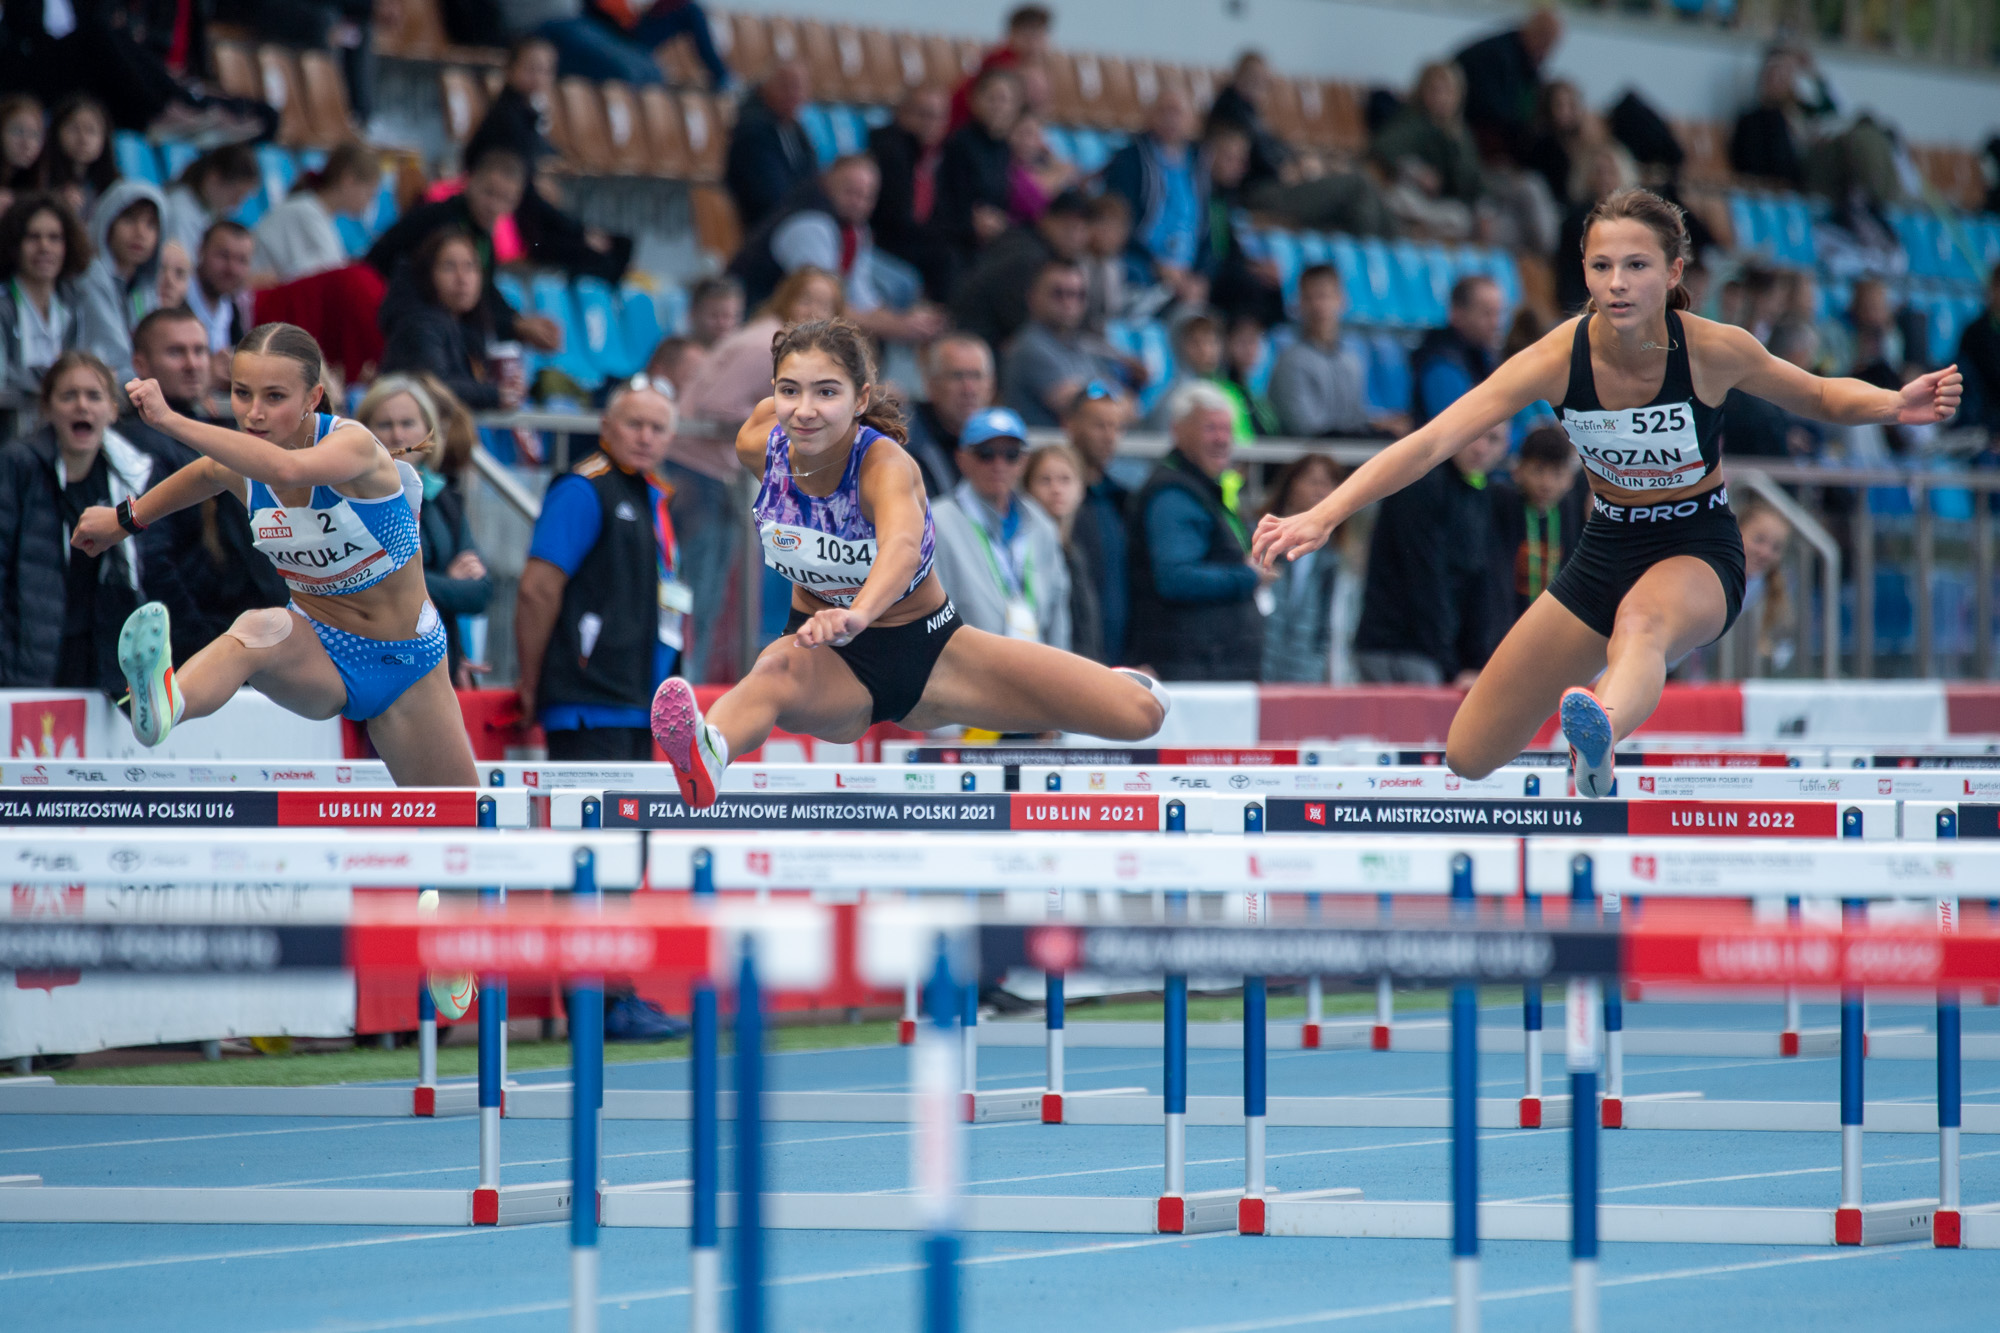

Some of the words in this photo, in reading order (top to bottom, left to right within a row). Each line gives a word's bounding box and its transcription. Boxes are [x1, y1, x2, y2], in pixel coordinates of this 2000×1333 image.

[1632, 407, 1686, 434] 525
[1582, 445, 1683, 466] KOZAN
[1602, 467, 1644, 488] LUBLIN
[1649, 474, 1685, 488] 2022
[1629, 500, 1699, 523] PRO
[260, 527, 292, 539] ORLEN
[316, 512, 338, 535] 2
[776, 536, 796, 546] LOTTO
[270, 541, 364, 568] KICUŁA
[815, 536, 873, 567] 1034
[296, 582, 338, 594] LUBLIN
[340, 568, 374, 588] 2022
[1180, 778, 1212, 789] FUEL
[1379, 777, 1424, 789] polanik
[36, 802, 144, 818] MISTRZOSTWA
[148, 803, 202, 818] POLSKI
[205, 802, 236, 818] U16
[318, 802, 383, 818] LUBLIN
[391, 802, 437, 818] 2022
[649, 803, 686, 818] PZLA
[689, 801, 788, 819] DRUŻYNOWE
[791, 804, 899, 820] MISTRZOSTWA
[903, 805, 956, 820] POLSKI
[960, 805, 996, 820] 2021
[1026, 805, 1091, 821] LUBLIN
[1100, 806, 1144, 821] 2021
[1333, 807, 1372, 823] PZLA
[1376, 808, 1489, 824] MISTRZOSTWA
[1493, 809, 1548, 825] POLSKI
[1552, 809, 1583, 826] U16
[1671, 811, 1738, 827] LUBLIN
[1747, 811, 1795, 828] 2022
